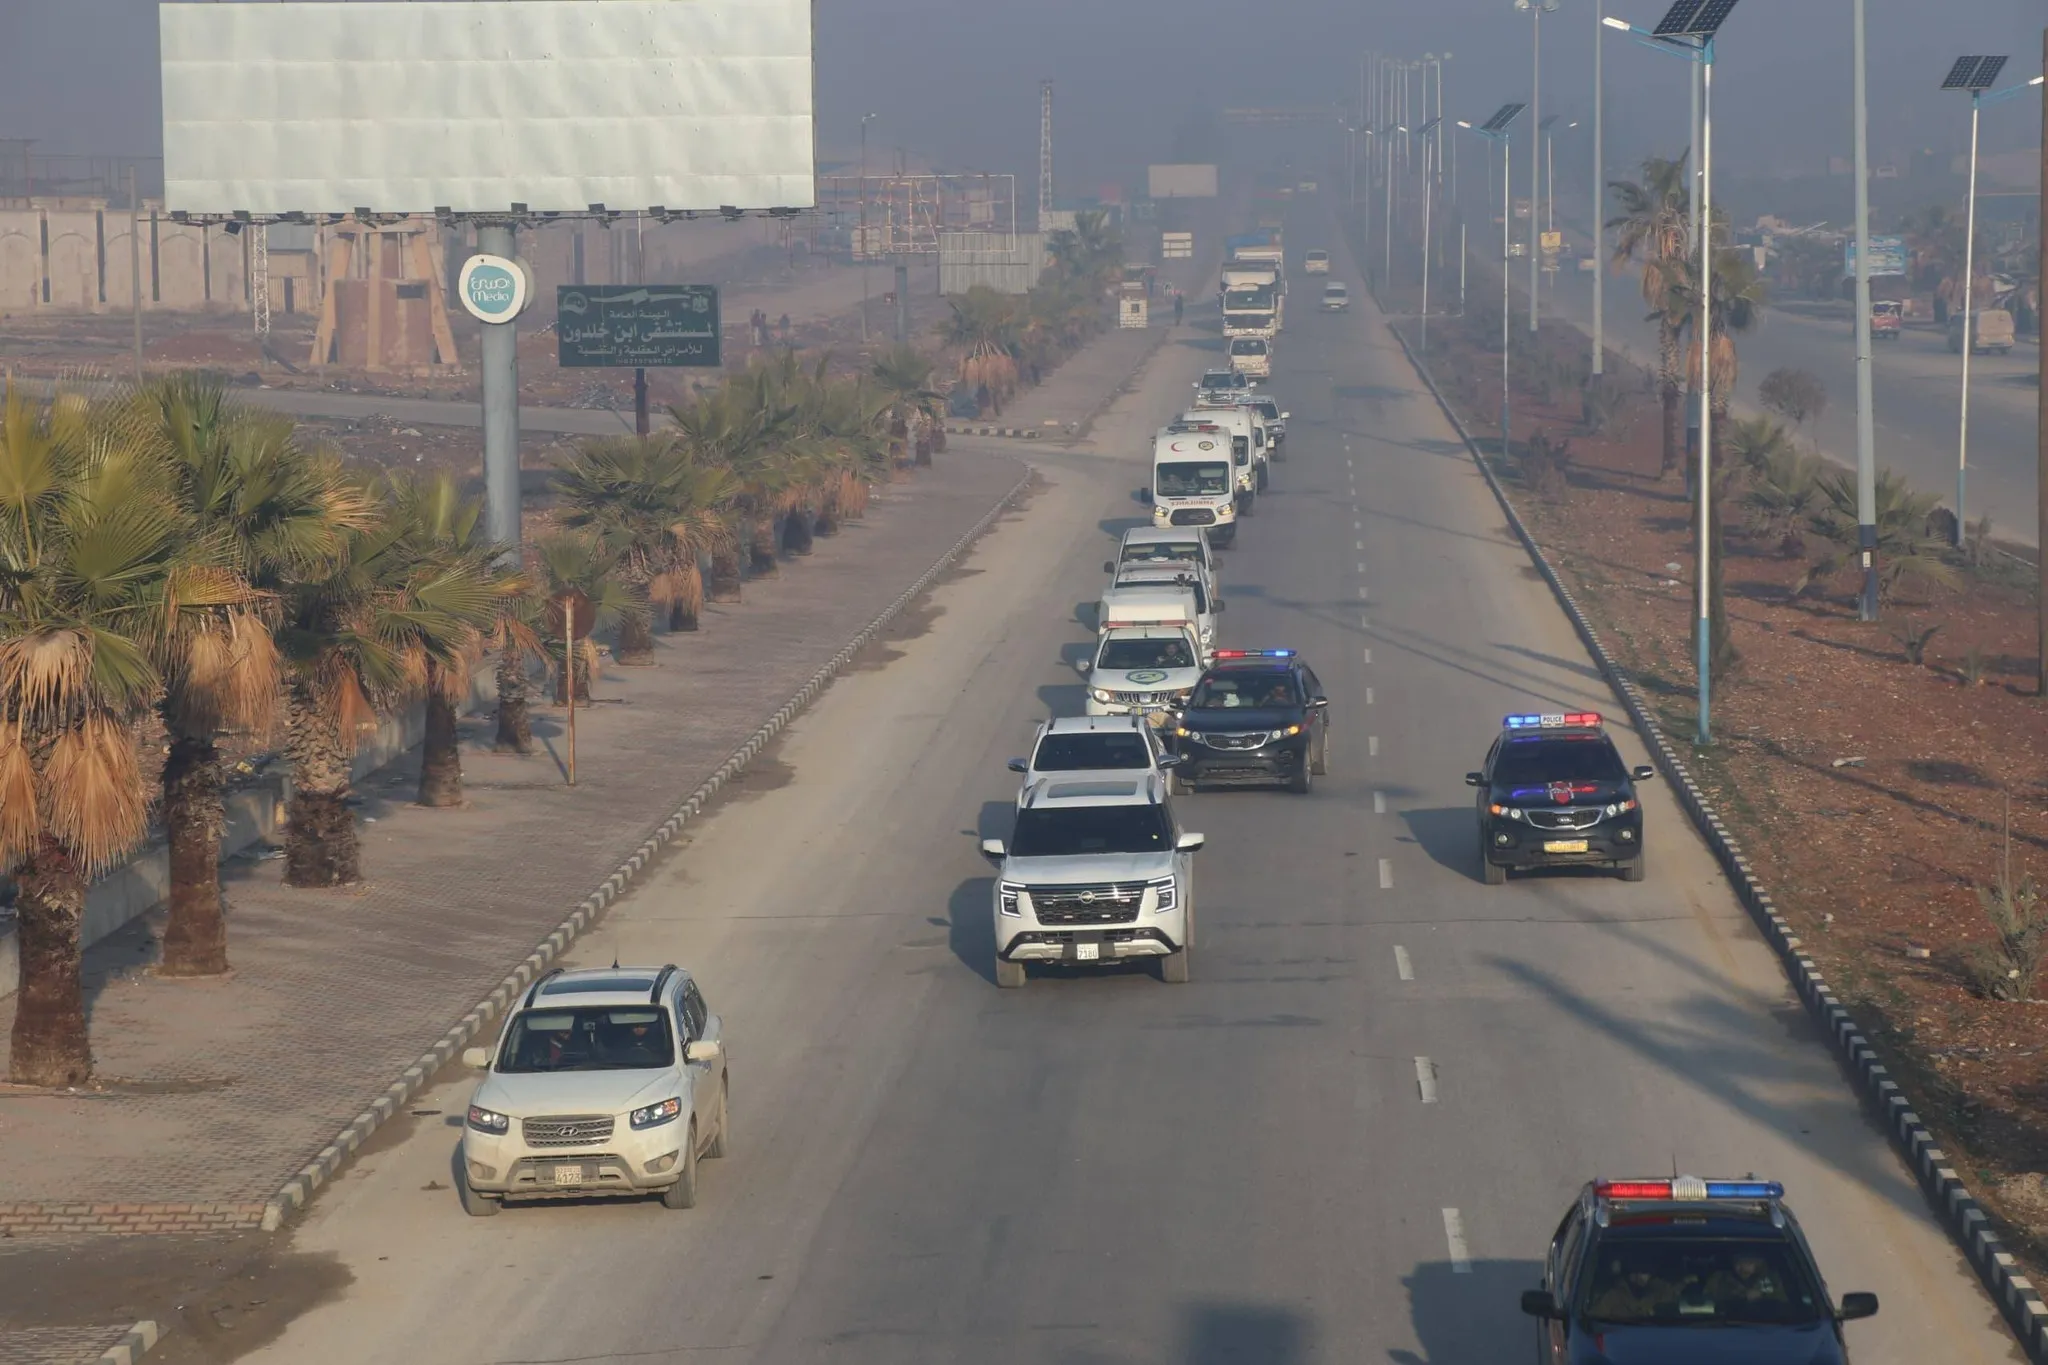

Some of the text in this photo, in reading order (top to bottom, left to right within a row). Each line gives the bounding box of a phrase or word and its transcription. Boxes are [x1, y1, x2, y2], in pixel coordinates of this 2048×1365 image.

[472, 290, 509, 302] Media
[609, 309, 638, 319] العامة
[563, 319, 714, 343] لمستشفى ابن خلدون
[624, 344, 661, 356] العقلية
[662, 343, 703, 357] للأمراض
